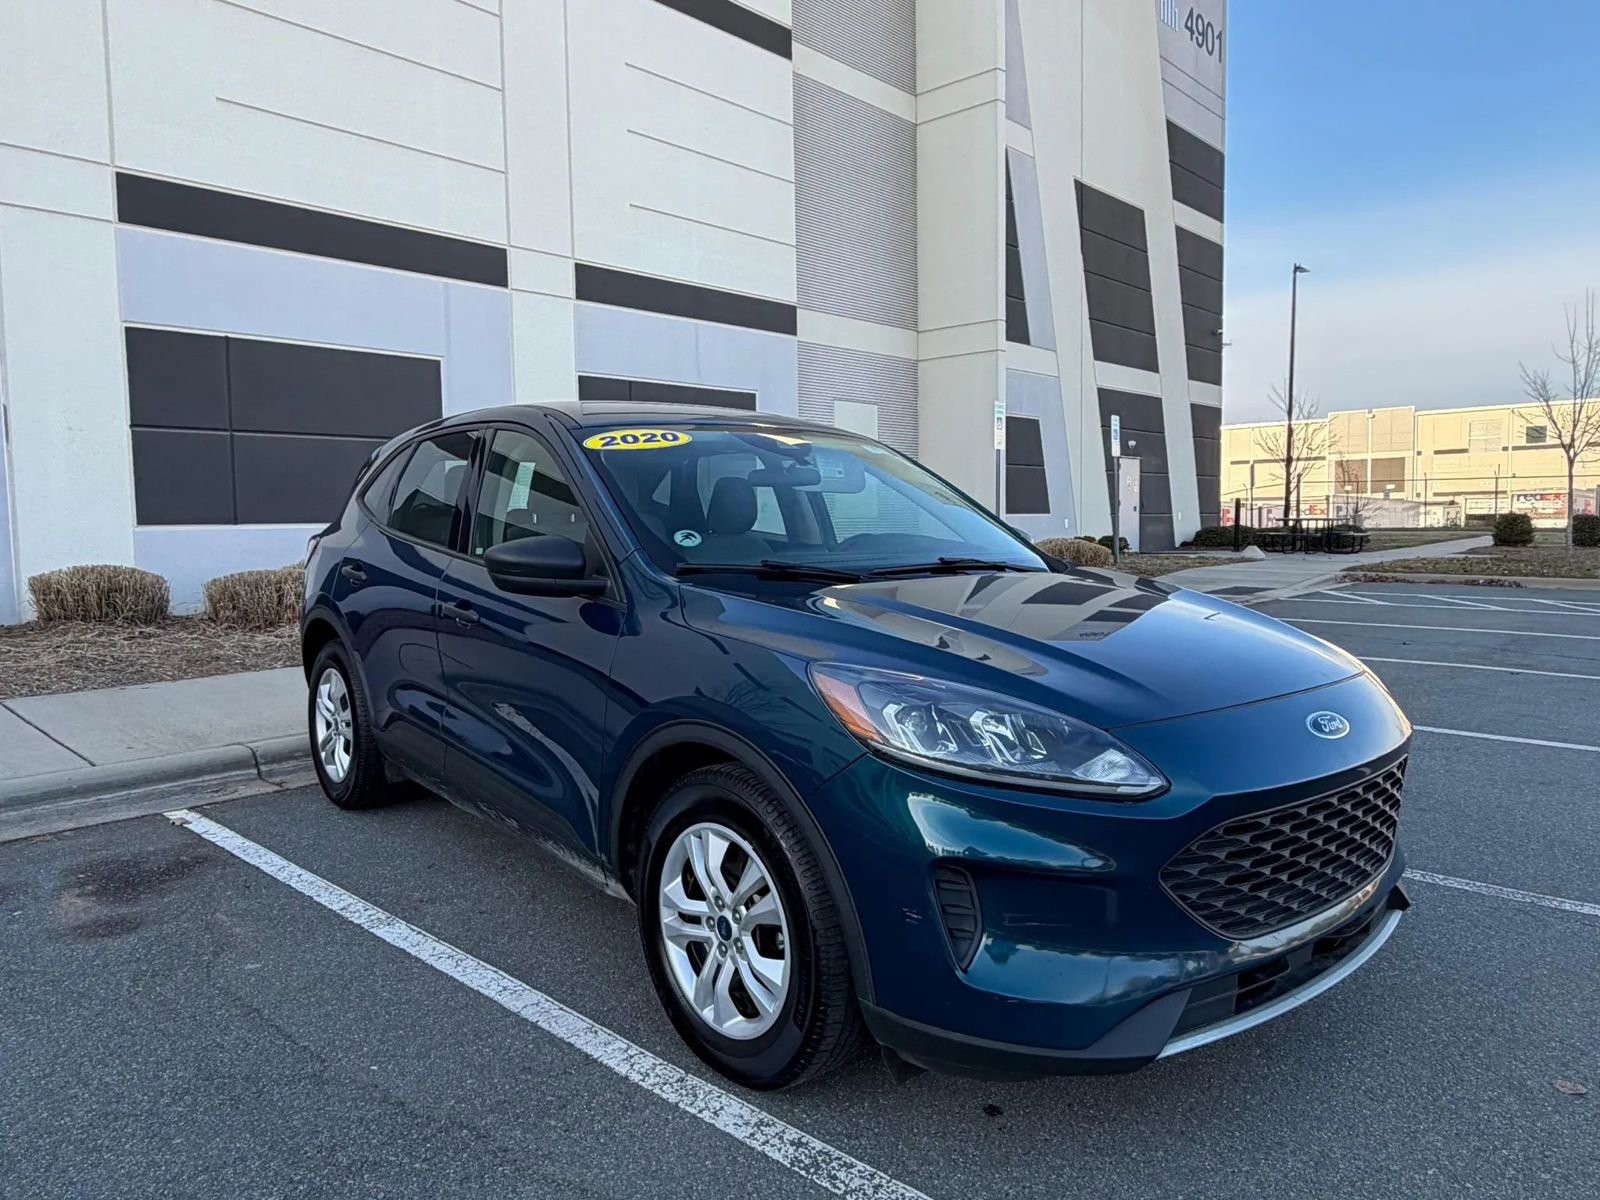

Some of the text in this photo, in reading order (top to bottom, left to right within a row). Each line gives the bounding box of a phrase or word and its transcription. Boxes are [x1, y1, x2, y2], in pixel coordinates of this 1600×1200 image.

[1184, 7, 1222, 63] 4901
[599, 432, 680, 448] 2020
[1317, 715, 1343, 732] Ford
